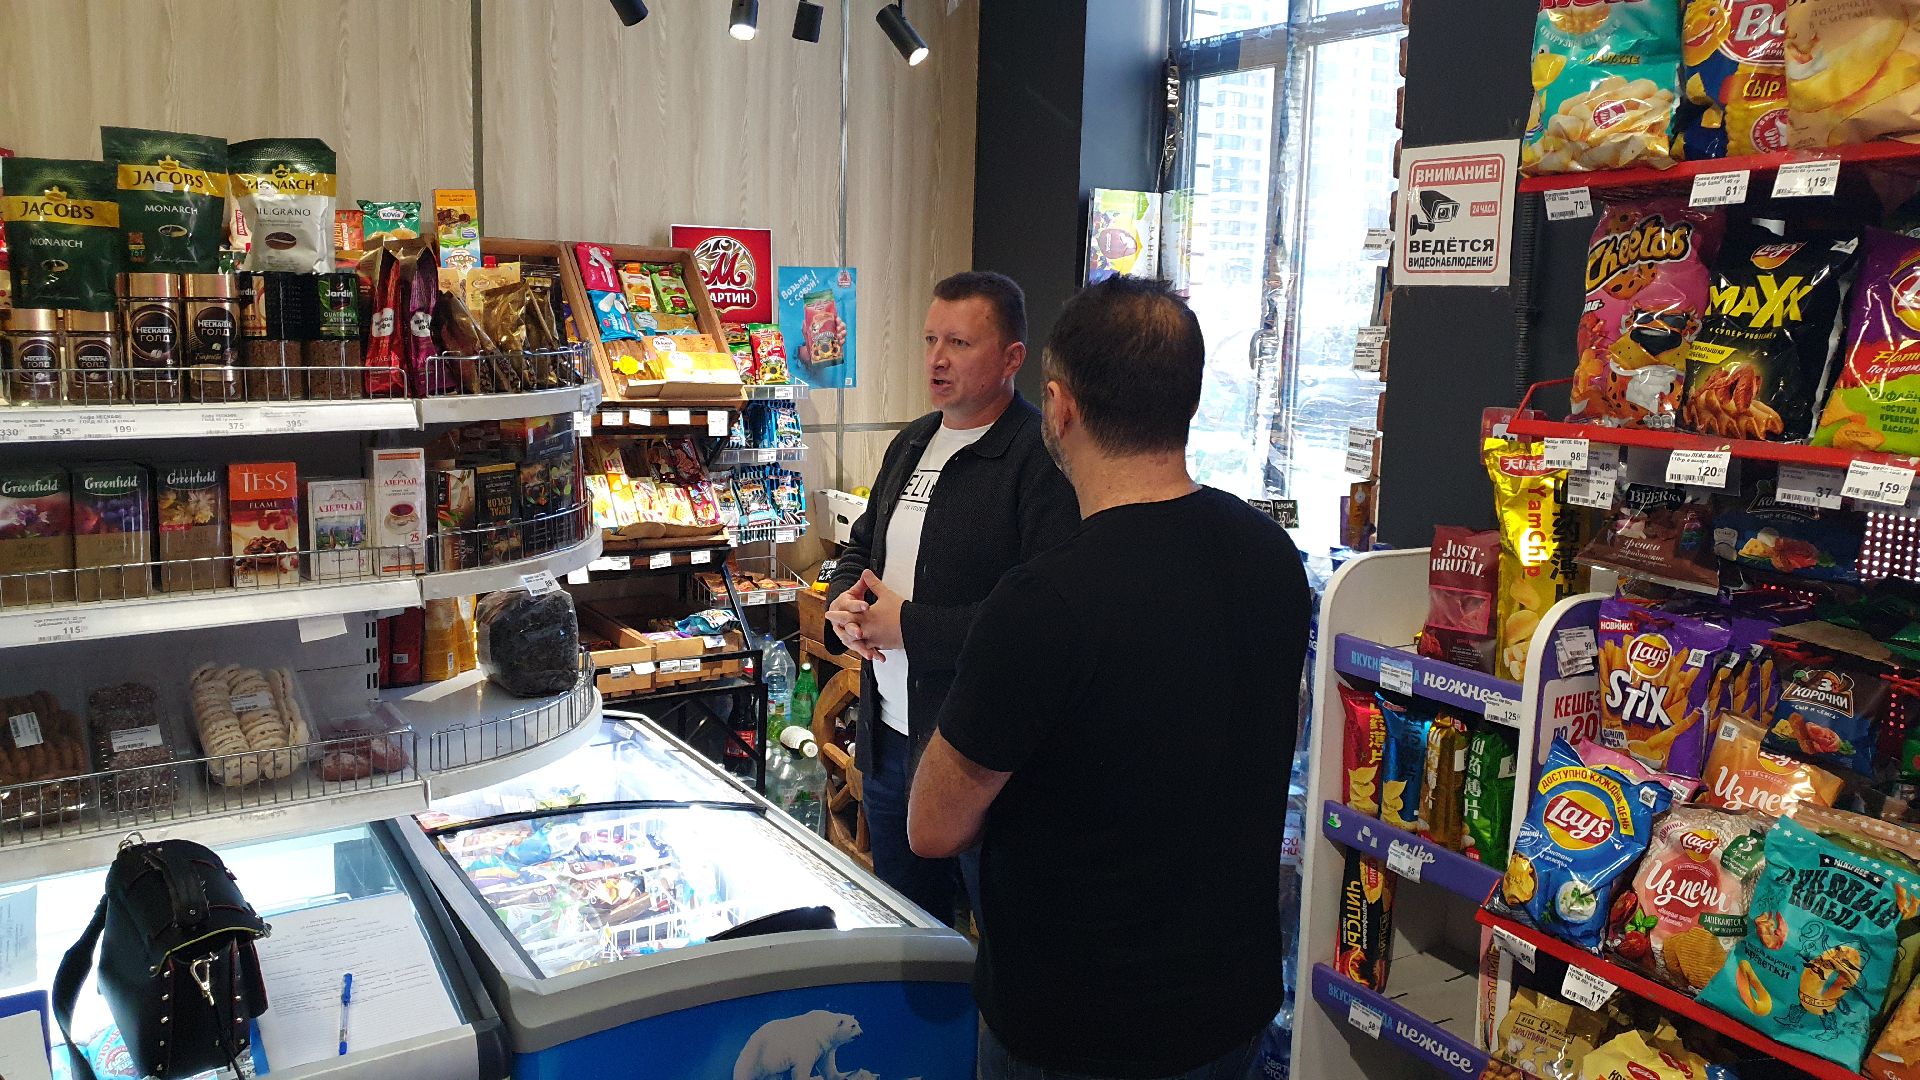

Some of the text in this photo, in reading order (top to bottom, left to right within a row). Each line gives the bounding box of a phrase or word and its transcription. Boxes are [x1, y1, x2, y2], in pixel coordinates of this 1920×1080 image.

[1743, 79, 1781, 98] СЫР
[132, 169, 204, 188] JACOBS
[1416, 164, 1498, 183] ВНИМАНИЕ!
[246, 178, 316, 192] MONARCH
[20, 200, 95, 220] JACOBS
[144, 204, 198, 216] MONARCH
[271, 207, 312, 217] GRANO
[1472, 205, 1496, 214] 24 ЧАСА
[29, 237, 83, 249] MONARCH
[1409, 237, 1495, 255] ВЕДЁТСЯ
[1408, 256, 1494, 269] ВИДЕОНАБЛЮДЕНИЕ
[1585, 222, 1689, 292] Cheetos
[325, 289, 354, 298] Jardin
[710, 292, 751, 304] АРТИН
[1704, 275, 1814, 328] MAXX
[197, 319, 233, 328] НЕСКАФЕ
[140, 334, 171, 343] ГОЛД
[201, 328, 230, 337] ГОЛД
[53, 427, 72, 436] 355
[114, 425, 132, 433] 199
[229, 422, 245, 430] 375
[1570, 452, 1581, 461] 98
[166, 470, 216, 485] Greenfield
[1697, 466, 1718, 478] 120
[2, 479, 59, 494] Greenfield
[84, 475, 139, 490] Greenfield
[241, 469, 289, 493] TESS
[383, 477, 418, 487] АЗЕРЧАЙ
[1878, 481, 1900, 494] 159
[1596, 491, 1606, 500] 74
[1816, 487, 1832, 498] 37
[249, 501, 279, 509] FLAME
[317, 500, 364, 514] АЗЕРЧАЙ
[1523, 485, 1547, 577] YamChip
[1442, 539, 1480, 560] JUST
[1431, 558, 1485, 578] BRUTAL
[63, 626, 81, 634] 115
[1600, 620, 1634, 631] НОВИНКА
[1351, 650, 1381, 672] ВКУСН
[1553, 690, 1599, 719] КЕШБЭ
[1791, 686, 1849, 709] КОРОЧКИ
[1504, 710, 1518, 721] 125
[1541, 769, 1629, 830] ДОСТУПНО КАЖДЫЙ ДЕНЬ
[1546, 797, 1611, 839] Lay's
[1645, 859, 1690, 907] Из
[1676, 878, 1730, 913] печи
[1776, 866, 1901, 929] ЛУКОВЫЕ
[1788, 882, 1862, 931] КОЛЬЦА
[1346, 880, 1361, 949] ЧИПСЫ
[1396, 1020, 1475, 1075] нежнее
[1264, 1055, 1289, 1071] СВЯТ
